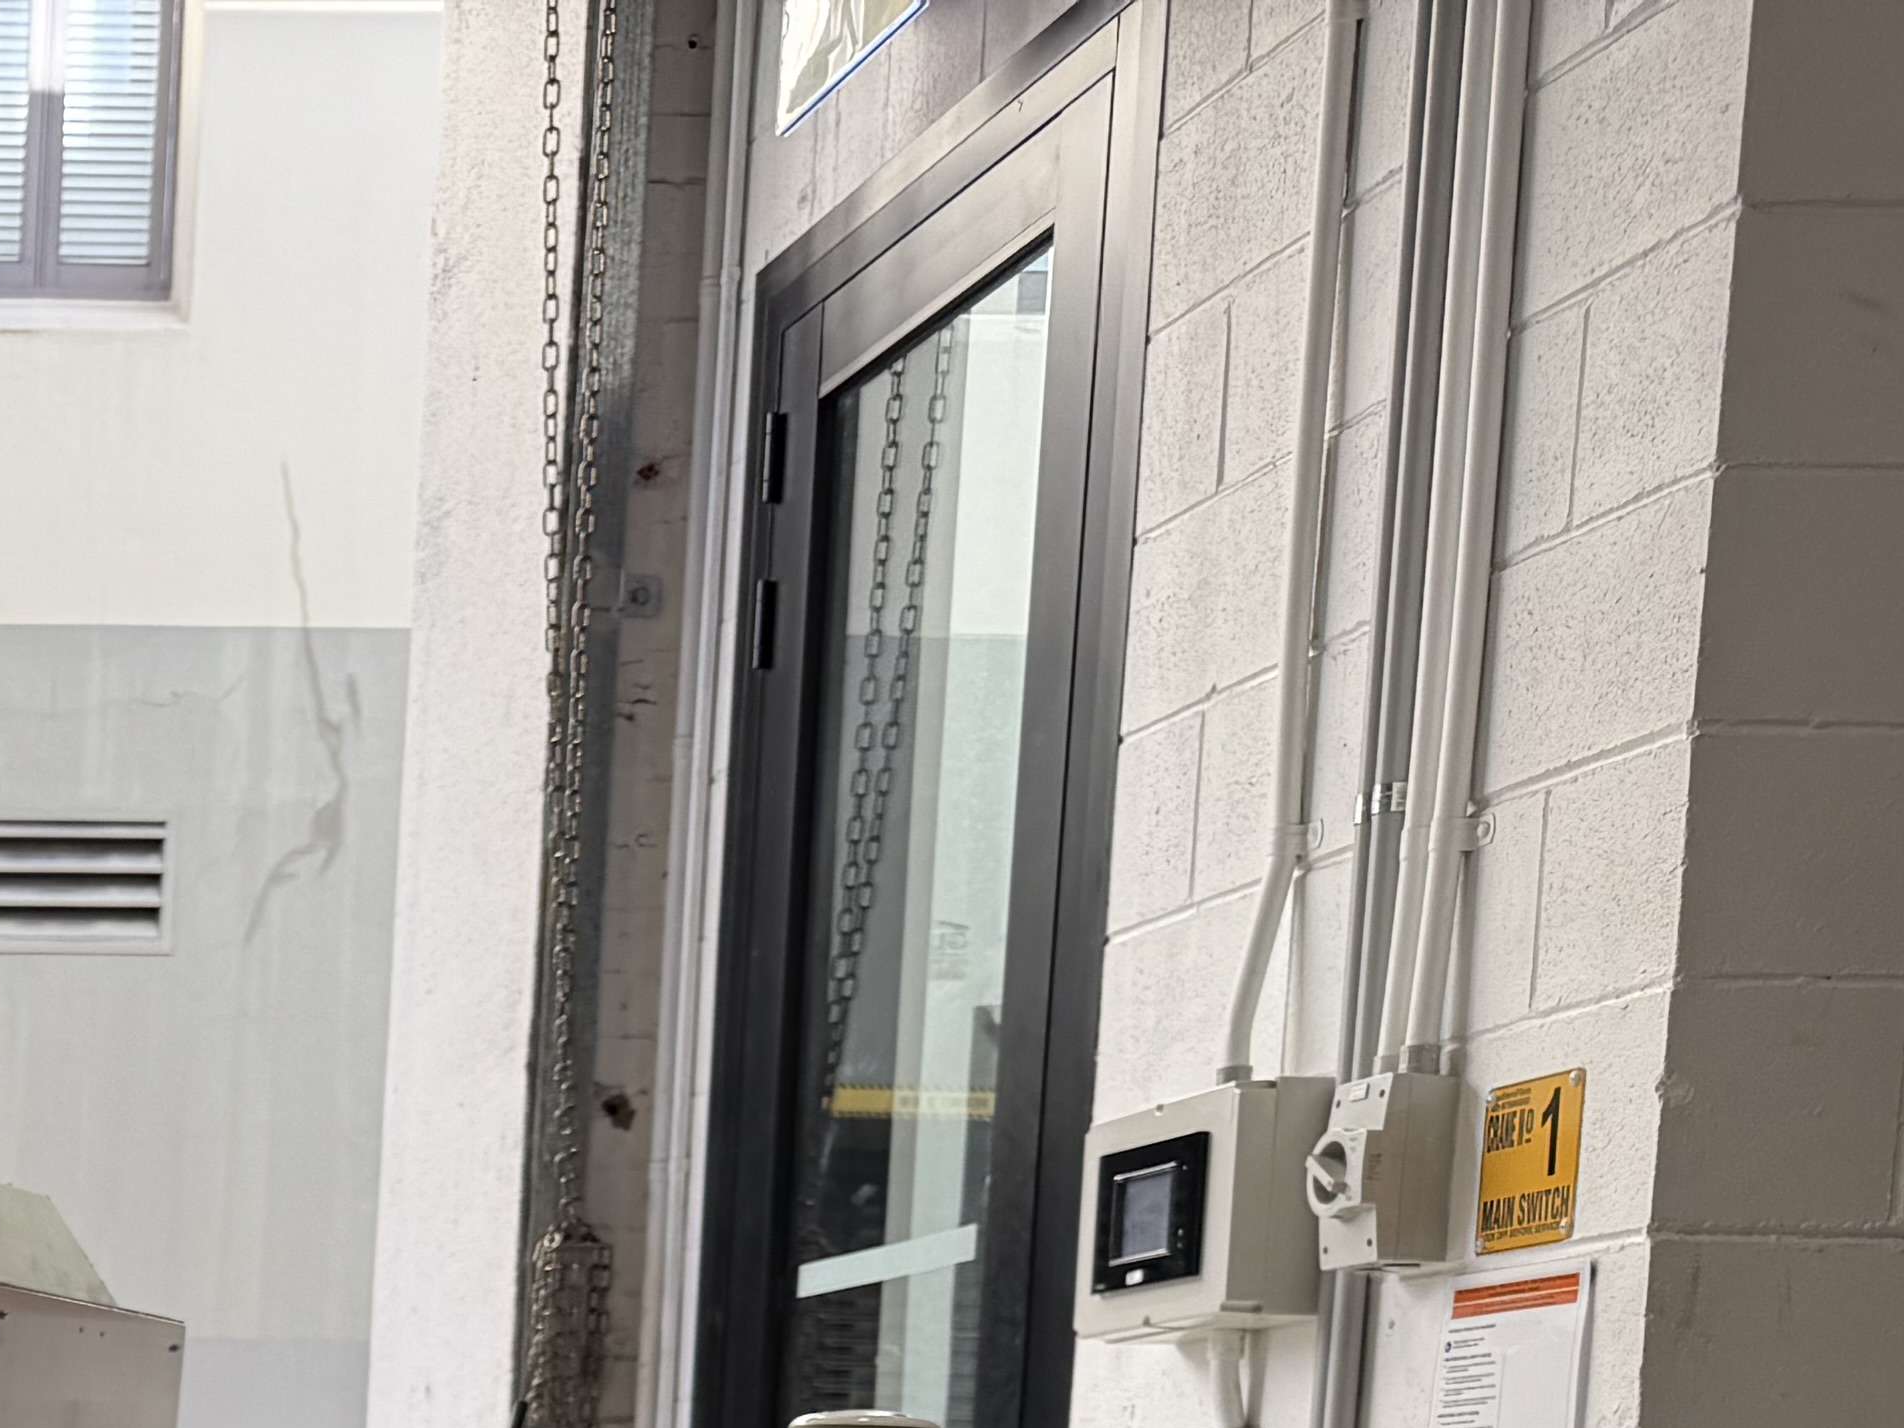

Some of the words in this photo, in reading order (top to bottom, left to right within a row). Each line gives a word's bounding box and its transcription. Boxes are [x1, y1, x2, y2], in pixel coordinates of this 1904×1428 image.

[1541, 1086, 1562, 1176] 1
[1481, 1196, 1516, 1232] MAIN
[1517, 1184, 1571, 1227] SWITCH
